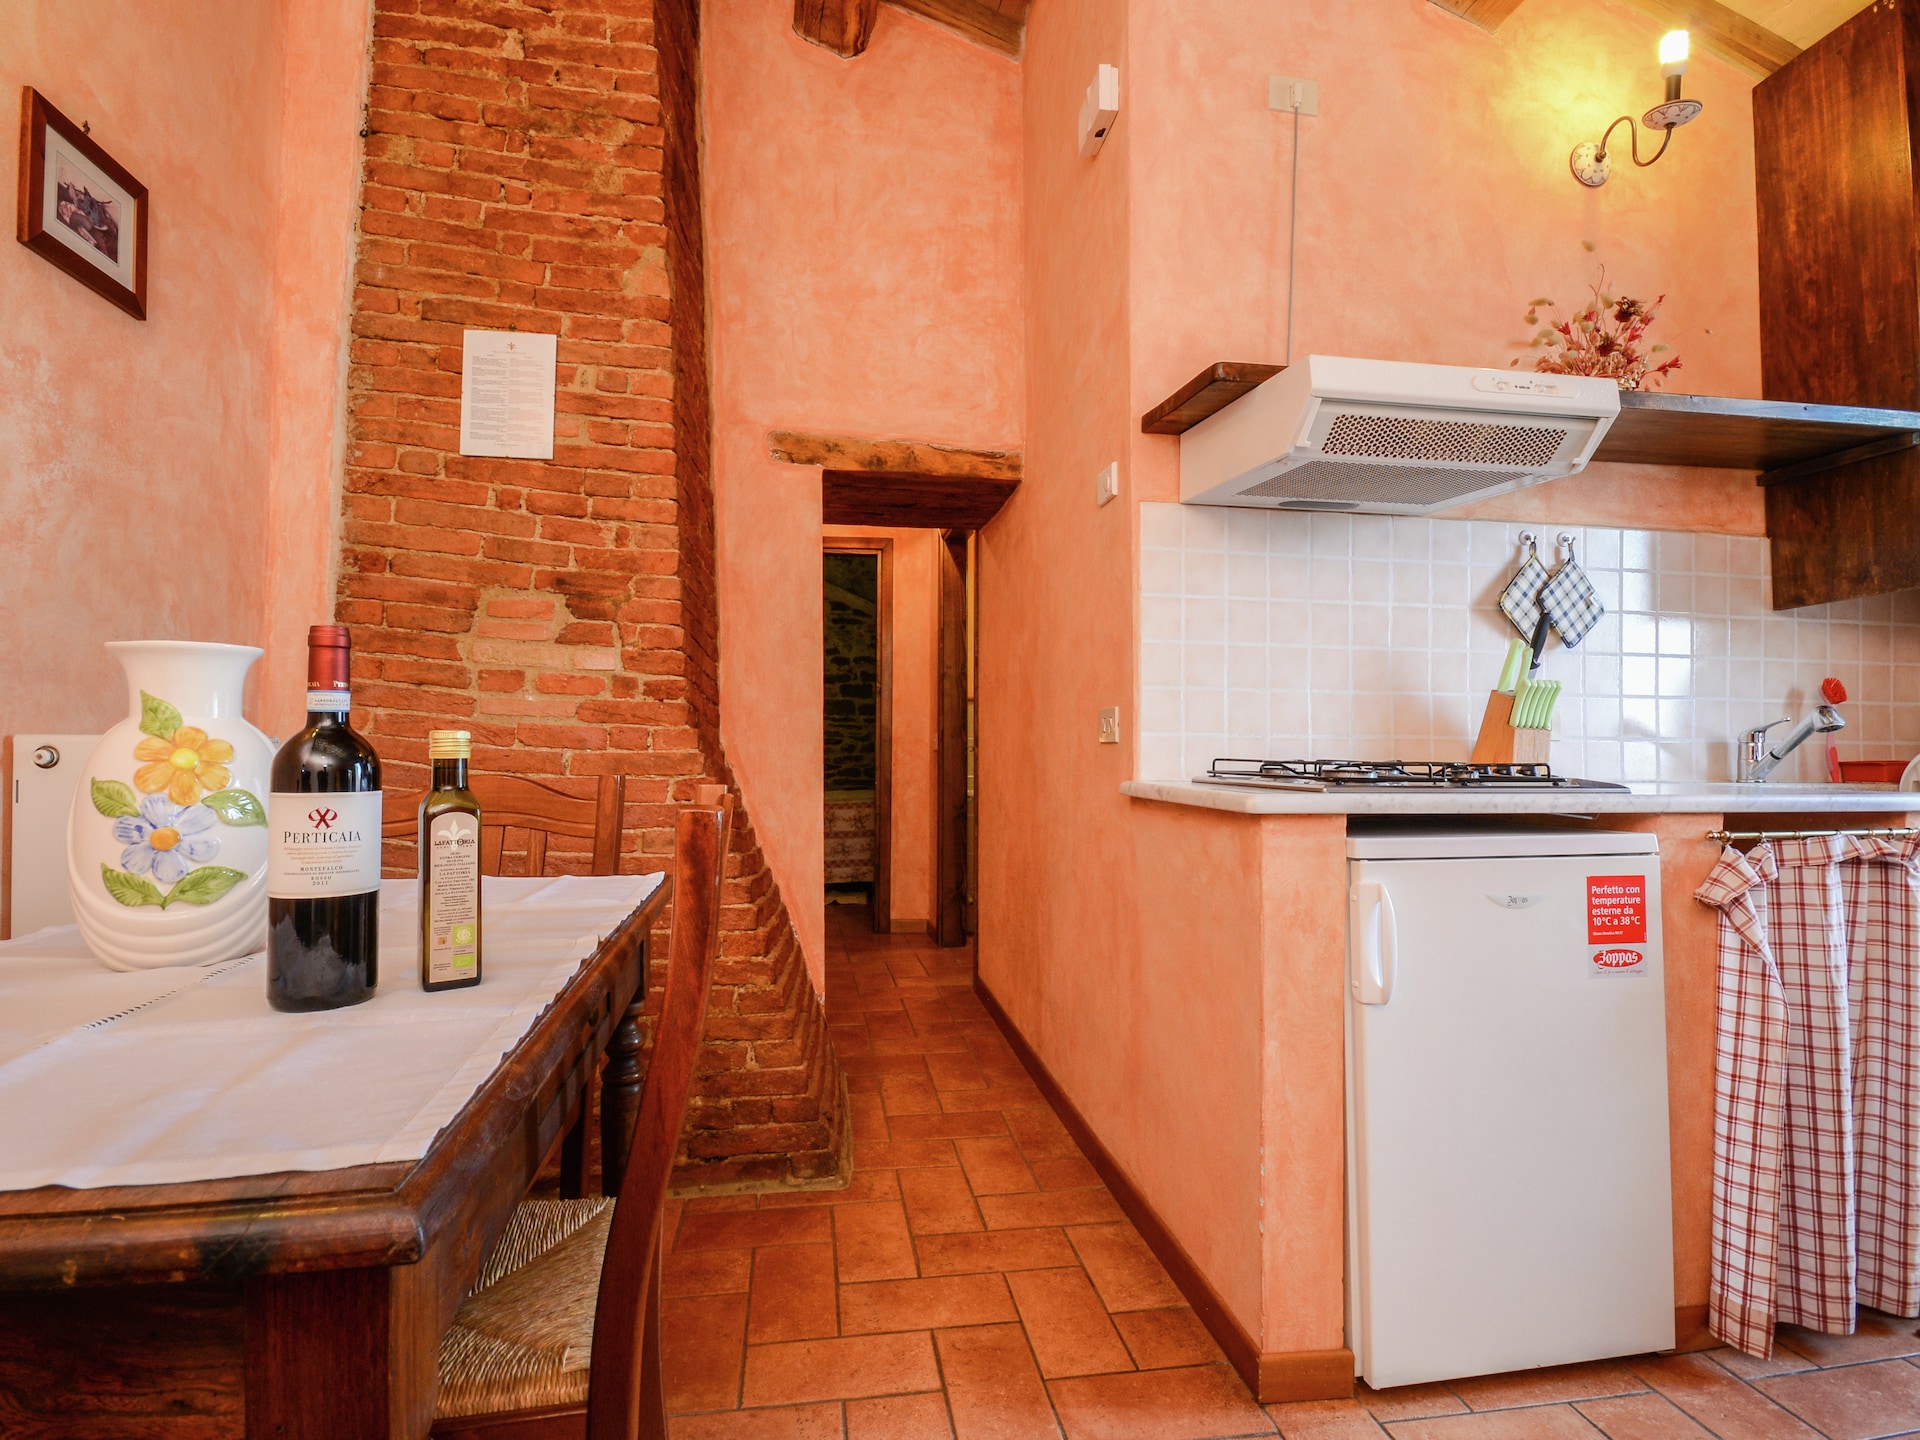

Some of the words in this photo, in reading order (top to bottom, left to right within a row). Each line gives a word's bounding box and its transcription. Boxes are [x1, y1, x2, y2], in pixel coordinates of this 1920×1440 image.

[283, 830, 362, 844] PERTICAIA
[1591, 885, 1624, 894] Perfetto
[1625, 886, 1640, 894] con
[1507, 895, 1529, 907] Zopas
[1591, 896, 1641, 906] temperature
[1592, 907, 1622, 916] esterne
[1623, 906, 1634, 915] da
[1593, 917, 1612, 926] 10°C
[1613, 918, 1619, 926] a
[1597, 949, 1639, 969] Zoppas
